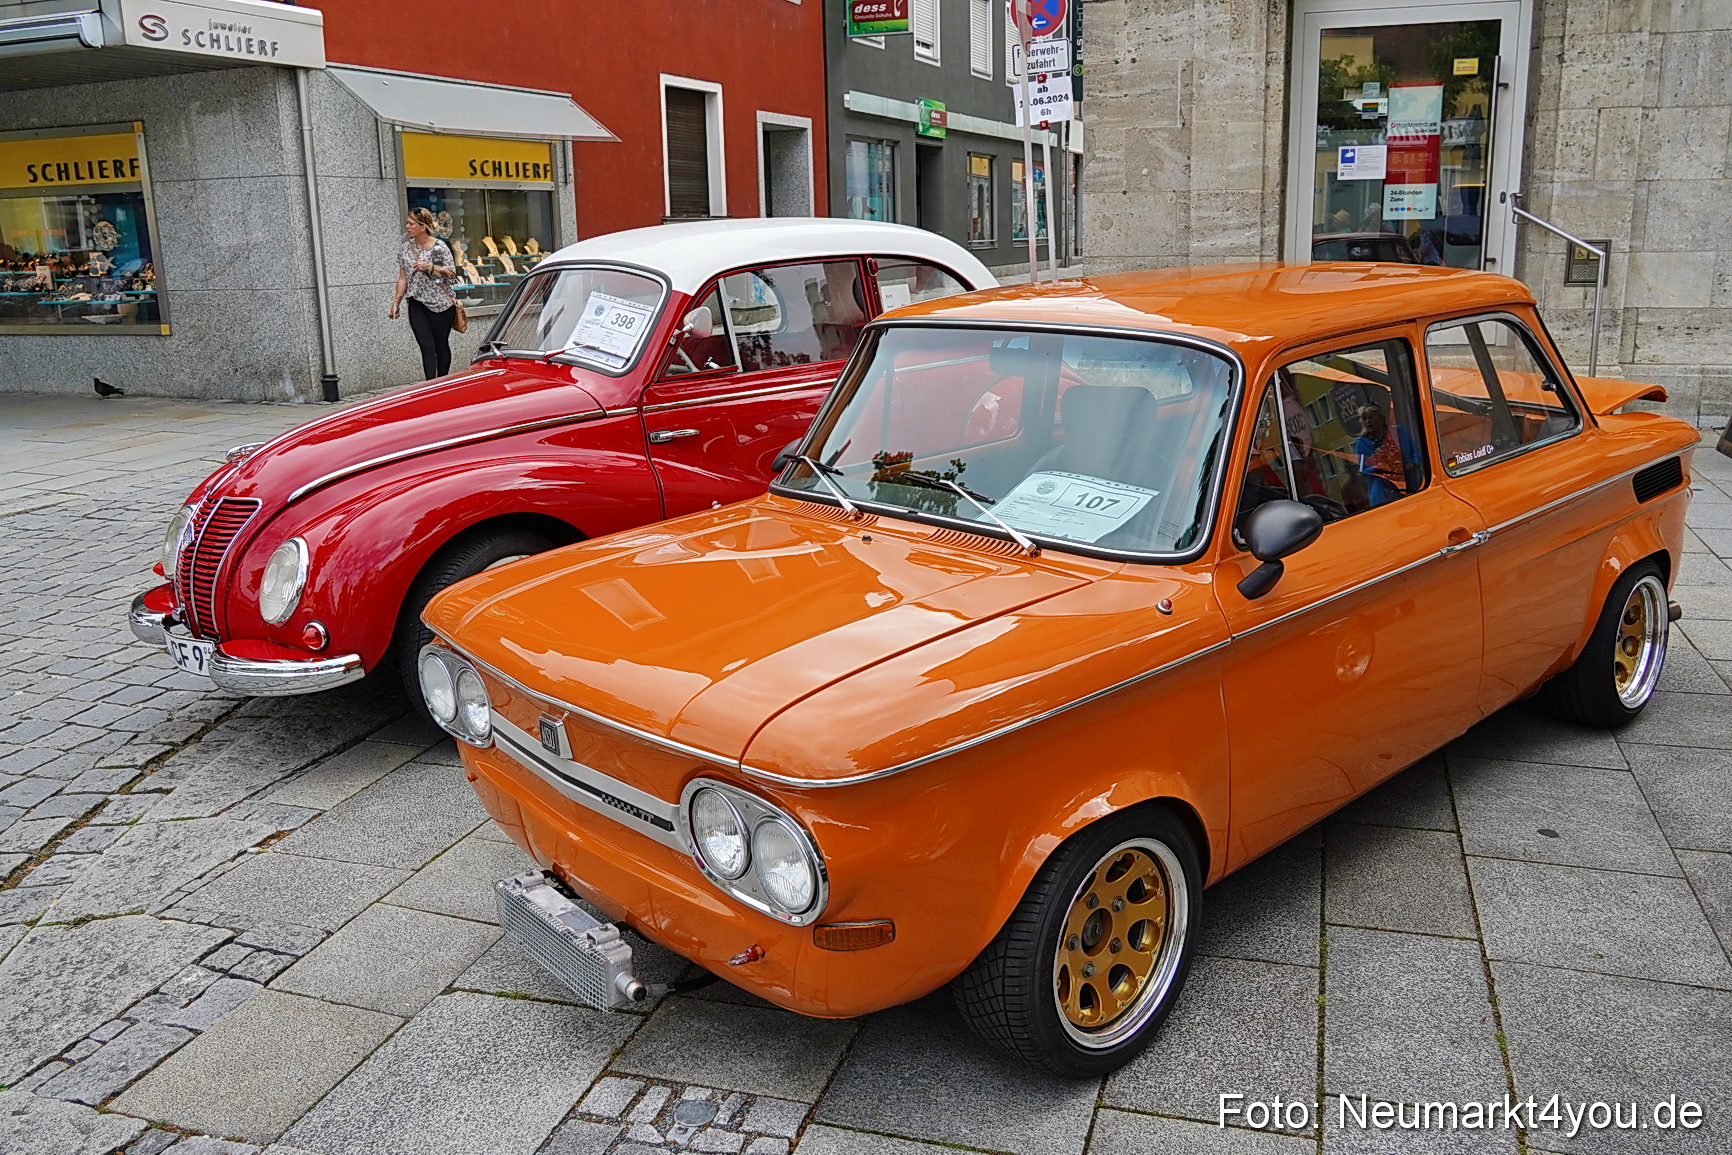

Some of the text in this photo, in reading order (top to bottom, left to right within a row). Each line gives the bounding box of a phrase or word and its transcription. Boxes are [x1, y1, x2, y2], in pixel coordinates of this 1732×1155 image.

[854, 3, 887, 14] dess
[208, 18, 253, 35] juwelier
[181, 28, 279, 57] SCHLIERF
[1016, 45, 1065, 60] Fuerwehr-
[1027, 57, 1056, 70] zufahrt
[1036, 84, 1049, 94] ab
[1019, 93, 1070, 109] 1.06.2024
[1040, 108, 1052, 117] 6h
[26, 158, 140, 183] SCHLIERF
[468, 158, 551, 179] SCHLIERF
[610, 312, 636, 330] 398
[1455, 452, 1473, 465] Tobias
[1074, 492, 1121, 512] 107
[192, 645, 204, 672] 9
[638, 809, 655, 823] TT
